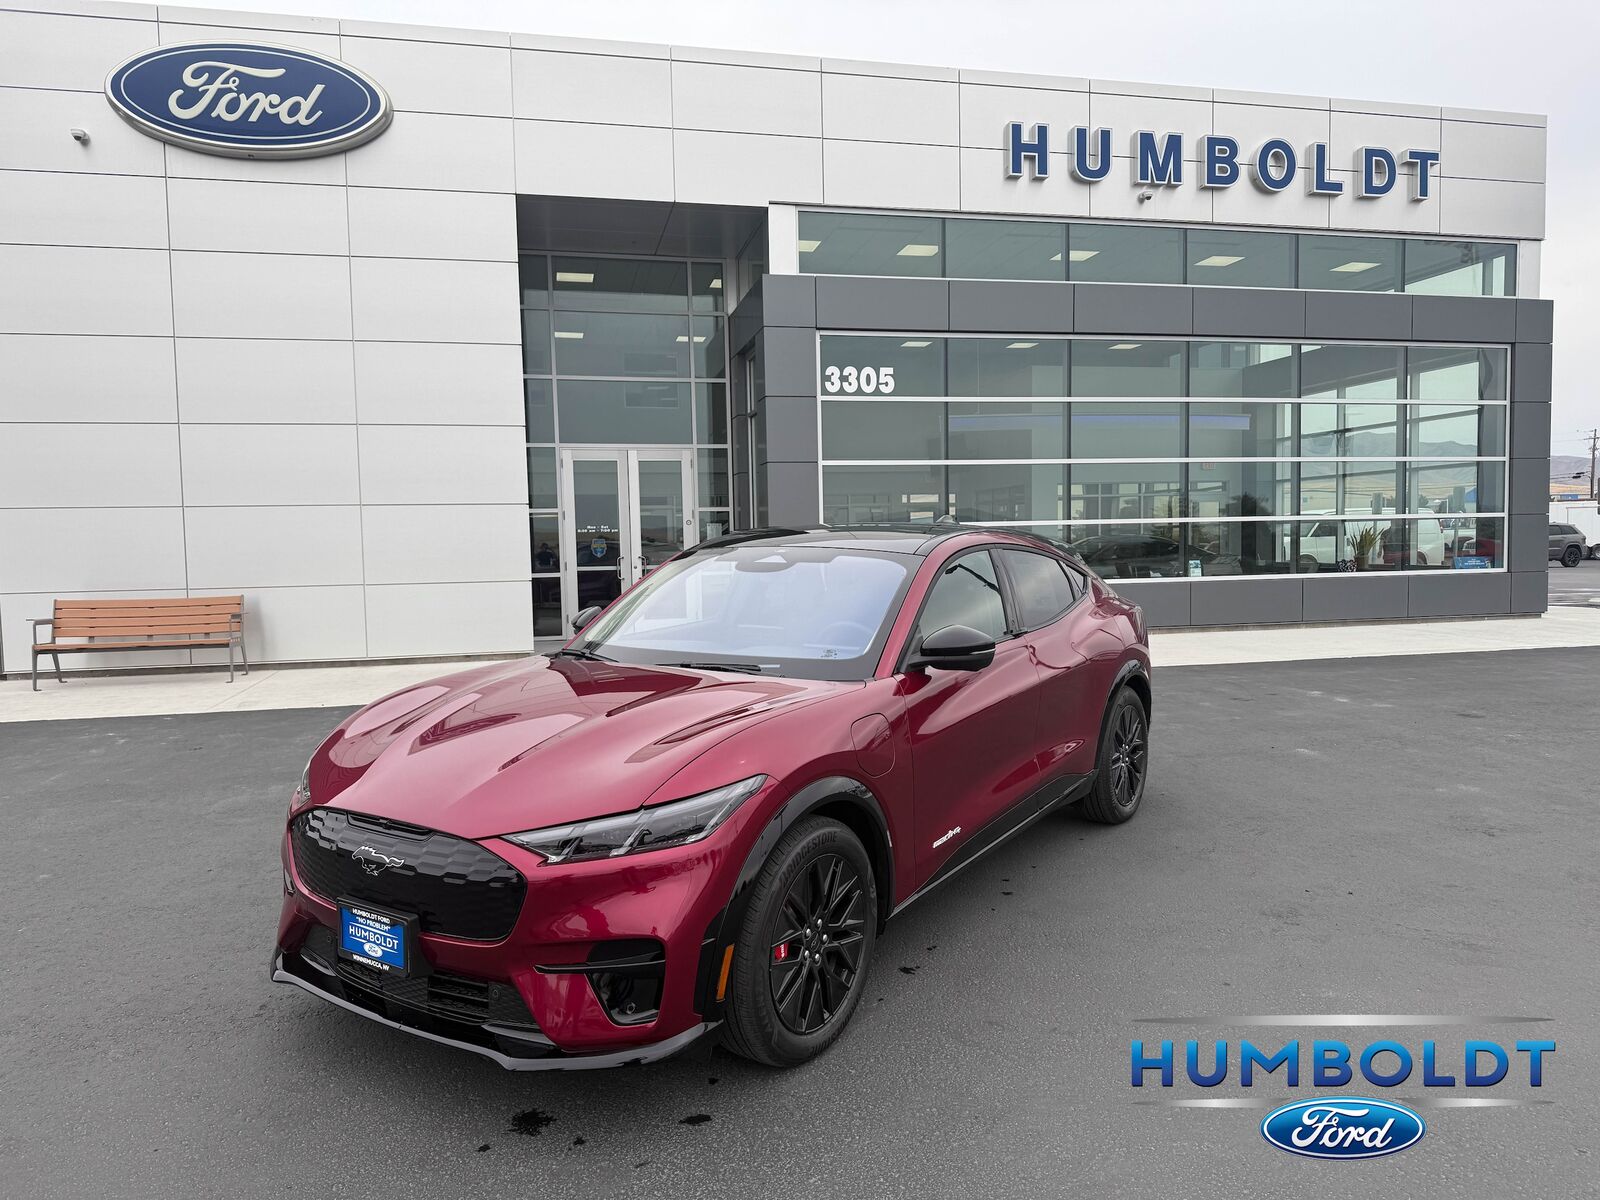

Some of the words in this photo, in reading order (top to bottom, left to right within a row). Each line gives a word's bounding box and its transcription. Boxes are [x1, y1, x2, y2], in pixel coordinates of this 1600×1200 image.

[168, 61, 325, 126] Ford
[1005, 120, 1441, 201] HUMBOLDT
[824, 365, 895, 394] 3305
[779, 831, 838, 889] BRIDGESTONE
[352, 908, 378, 920] HUMBOLDT
[378, 915, 390, 924] FORD
[366, 920, 390, 932] PROBLEM"
[349, 926, 398, 950] HUMBOLDT
